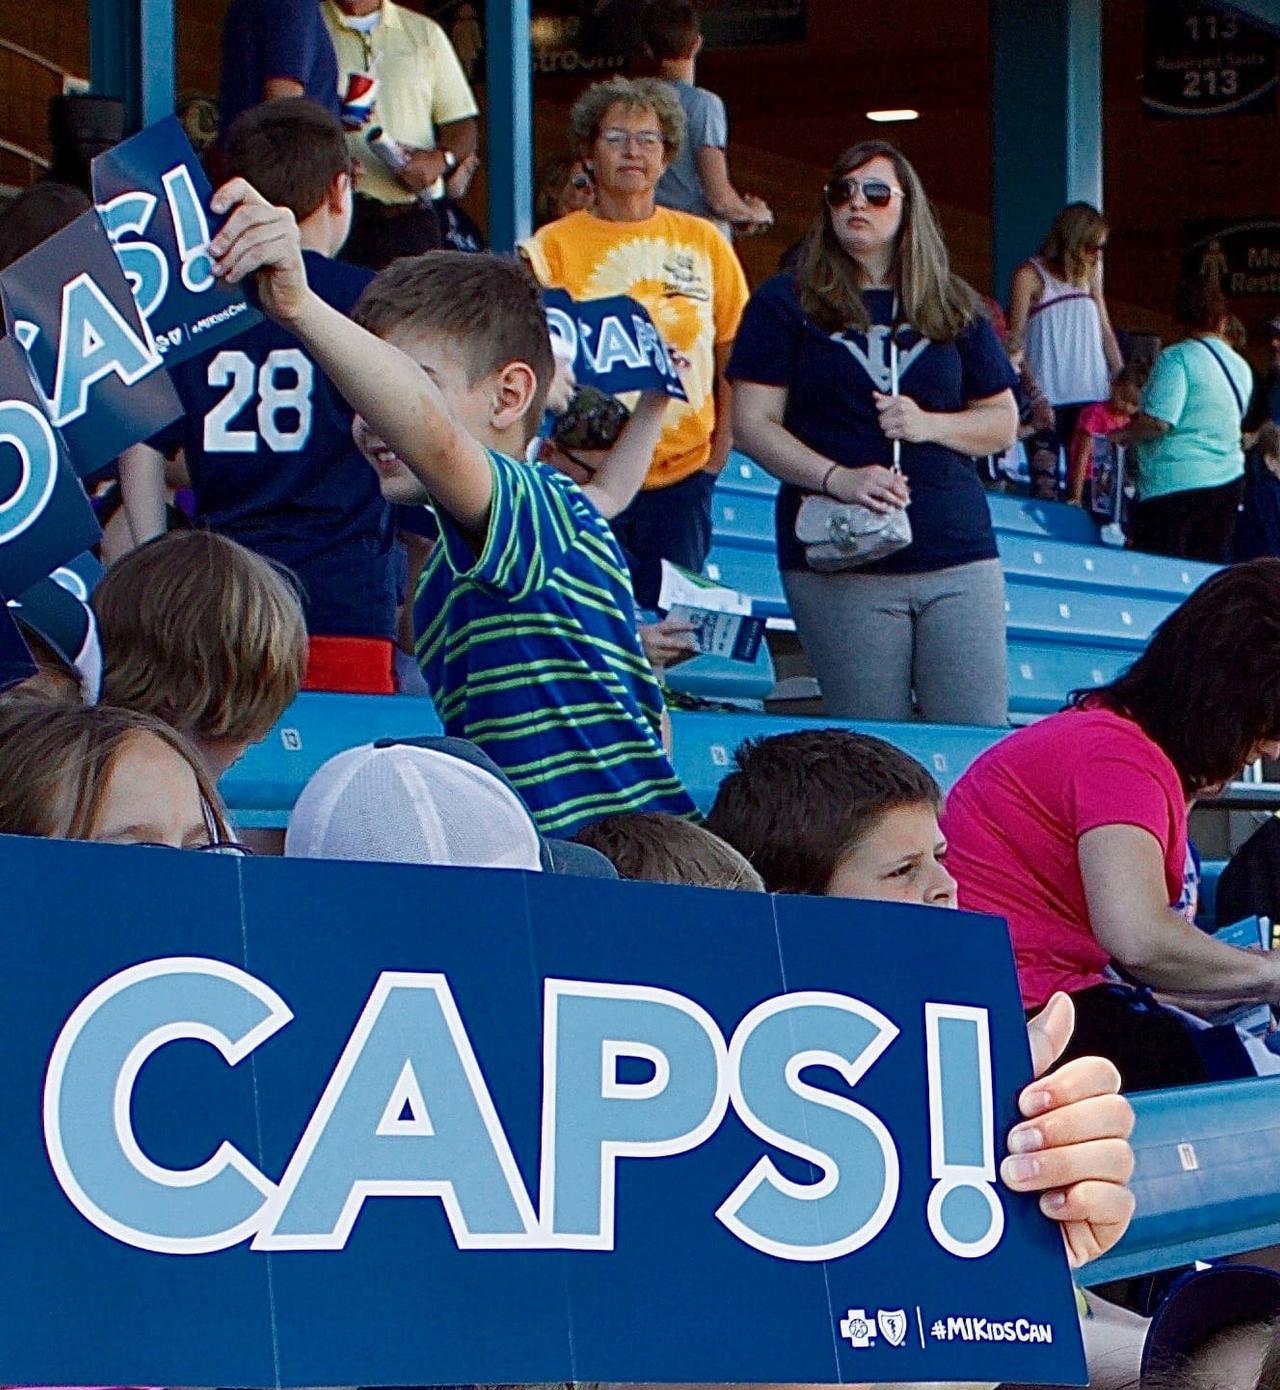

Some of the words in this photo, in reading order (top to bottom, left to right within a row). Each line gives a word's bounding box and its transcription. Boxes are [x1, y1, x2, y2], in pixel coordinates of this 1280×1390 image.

[1183, 69, 1239, 97] 213
[202, 348, 314, 454] 28
[43, 956, 1006, 1262] CAPS!
